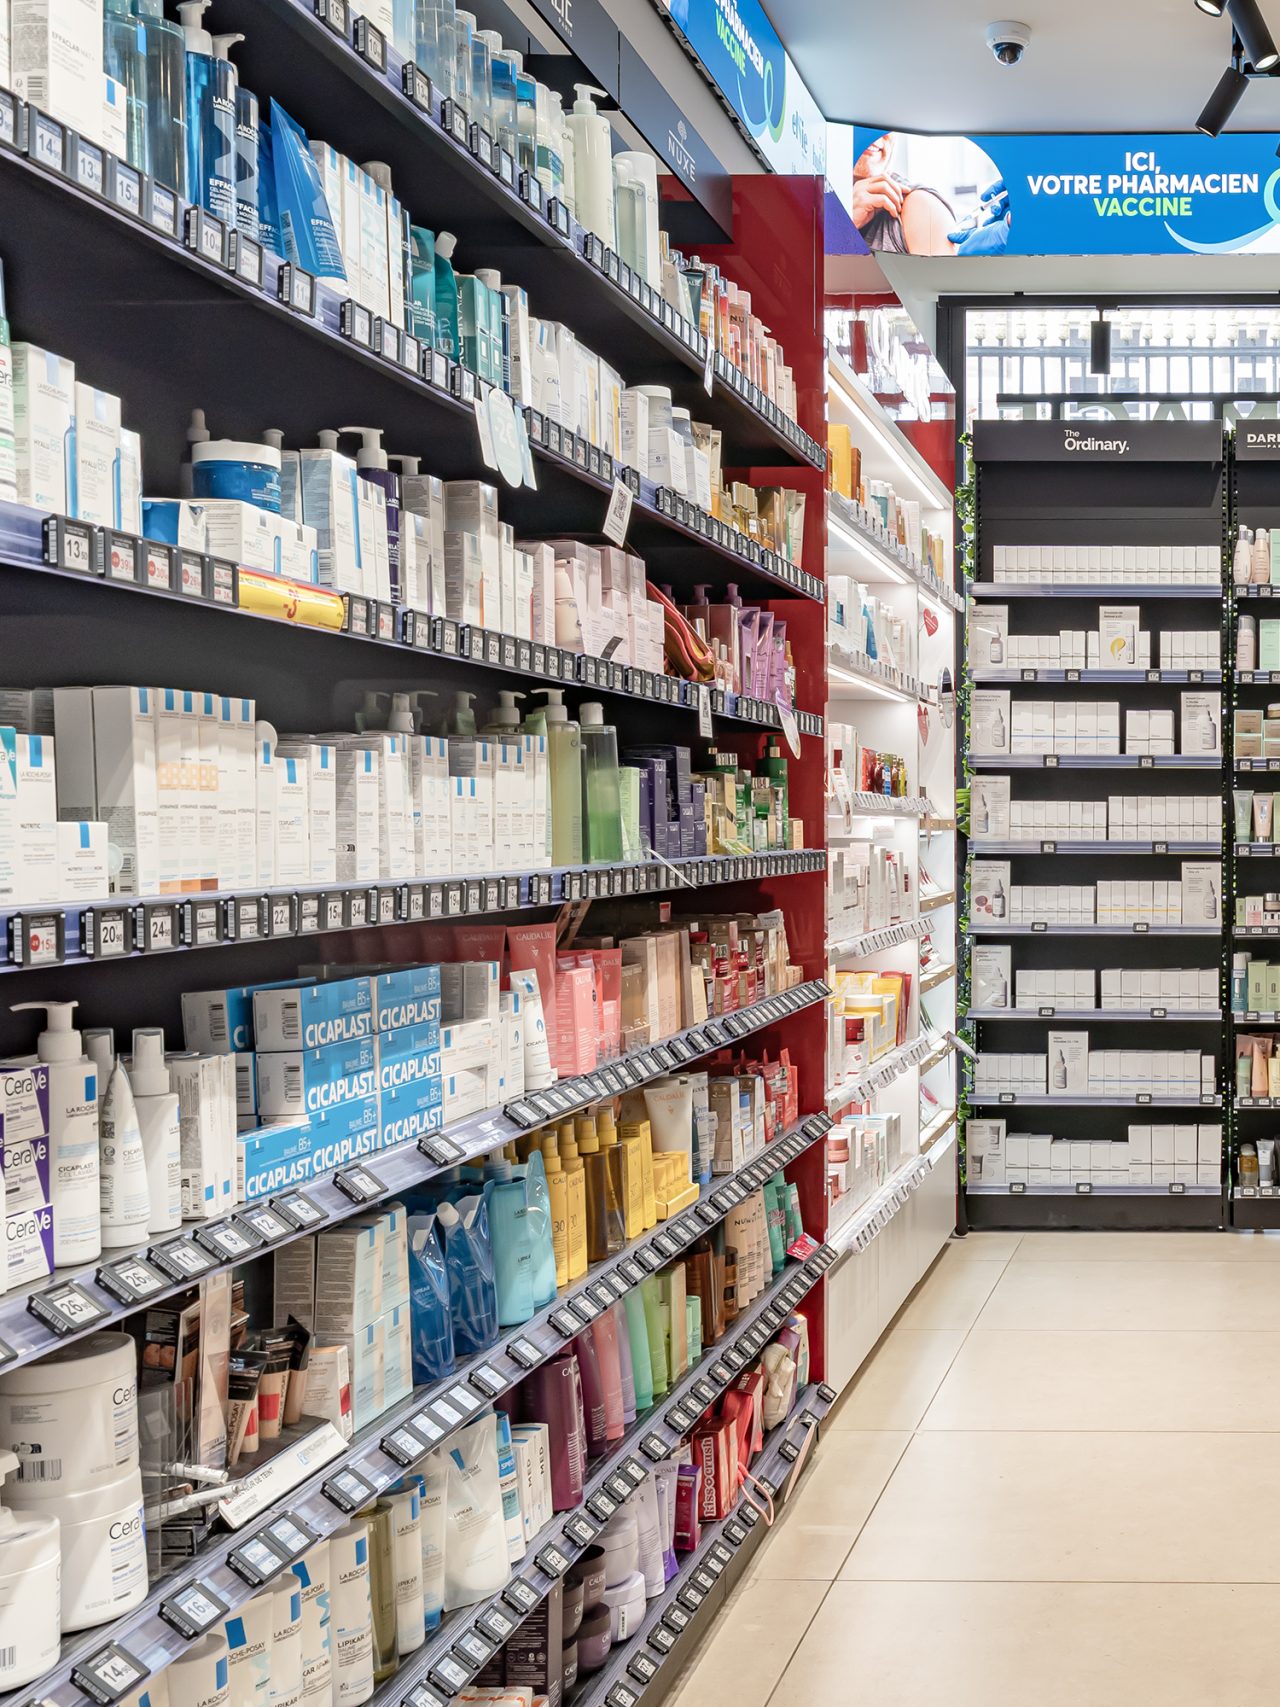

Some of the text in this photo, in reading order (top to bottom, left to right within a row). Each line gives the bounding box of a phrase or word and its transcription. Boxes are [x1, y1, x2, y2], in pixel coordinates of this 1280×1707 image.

[716, 8, 746, 78] VACCINE
[38, 131, 52, 154] 14
[80, 155, 94, 174] 13
[668, 135, 696, 183] NUXE
[1125, 152, 1161, 174] ICI,
[119, 181, 132, 200] 15
[1027, 174, 1259, 194] VOTRE PHARMACIEN
[1094, 197, 1192, 216] VACCINE
[1064, 430, 1080, 438] The
[1064, 438, 1130, 454] Ordinary.
[66, 540, 81, 558] 13
[274, 906, 285, 925] 22
[329, 904, 338, 920] 15
[352, 905, 361, 918] 34
[382, 902, 390, 915] 16
[102, 922, 116, 943] 20
[152, 919, 164, 938] 24
[516, 931, 552, 942] CAUDALIE
[379, 998, 440, 1030] CICAPLAST
[306, 1012, 371, 1048] CICAPLAST
[382, 1053, 441, 1088] CICAPLAST
[4, 1070, 46, 1096] CeraVe
[309, 1071, 373, 1106] CICAPLAST
[384, 1106, 442, 1145] CICAPLAST
[3, 1141, 46, 1169] CeraVe
[313, 1129, 377, 1172] CICAPLAST
[58, 1162, 94, 1173] CICAPLAST
[247, 1158, 312, 1197] CICAPLAST
[6, 1213, 51, 1241] CeraVe
[257, 1218, 273, 1231] 12
[554, 1220, 566, 1232] 30
[224, 1234, 234, 1246] 9
[177, 1252, 194, 1266] 11
[125, 1271, 146, 1287] 26
[60, 1300, 82, 1316] 26
[703, 1436, 717, 1518] kiss crush
[187, 1599, 206, 1617] 16
[337, 1634, 365, 1649] LIPIKAR
[103, 1666, 121, 1684] 14
